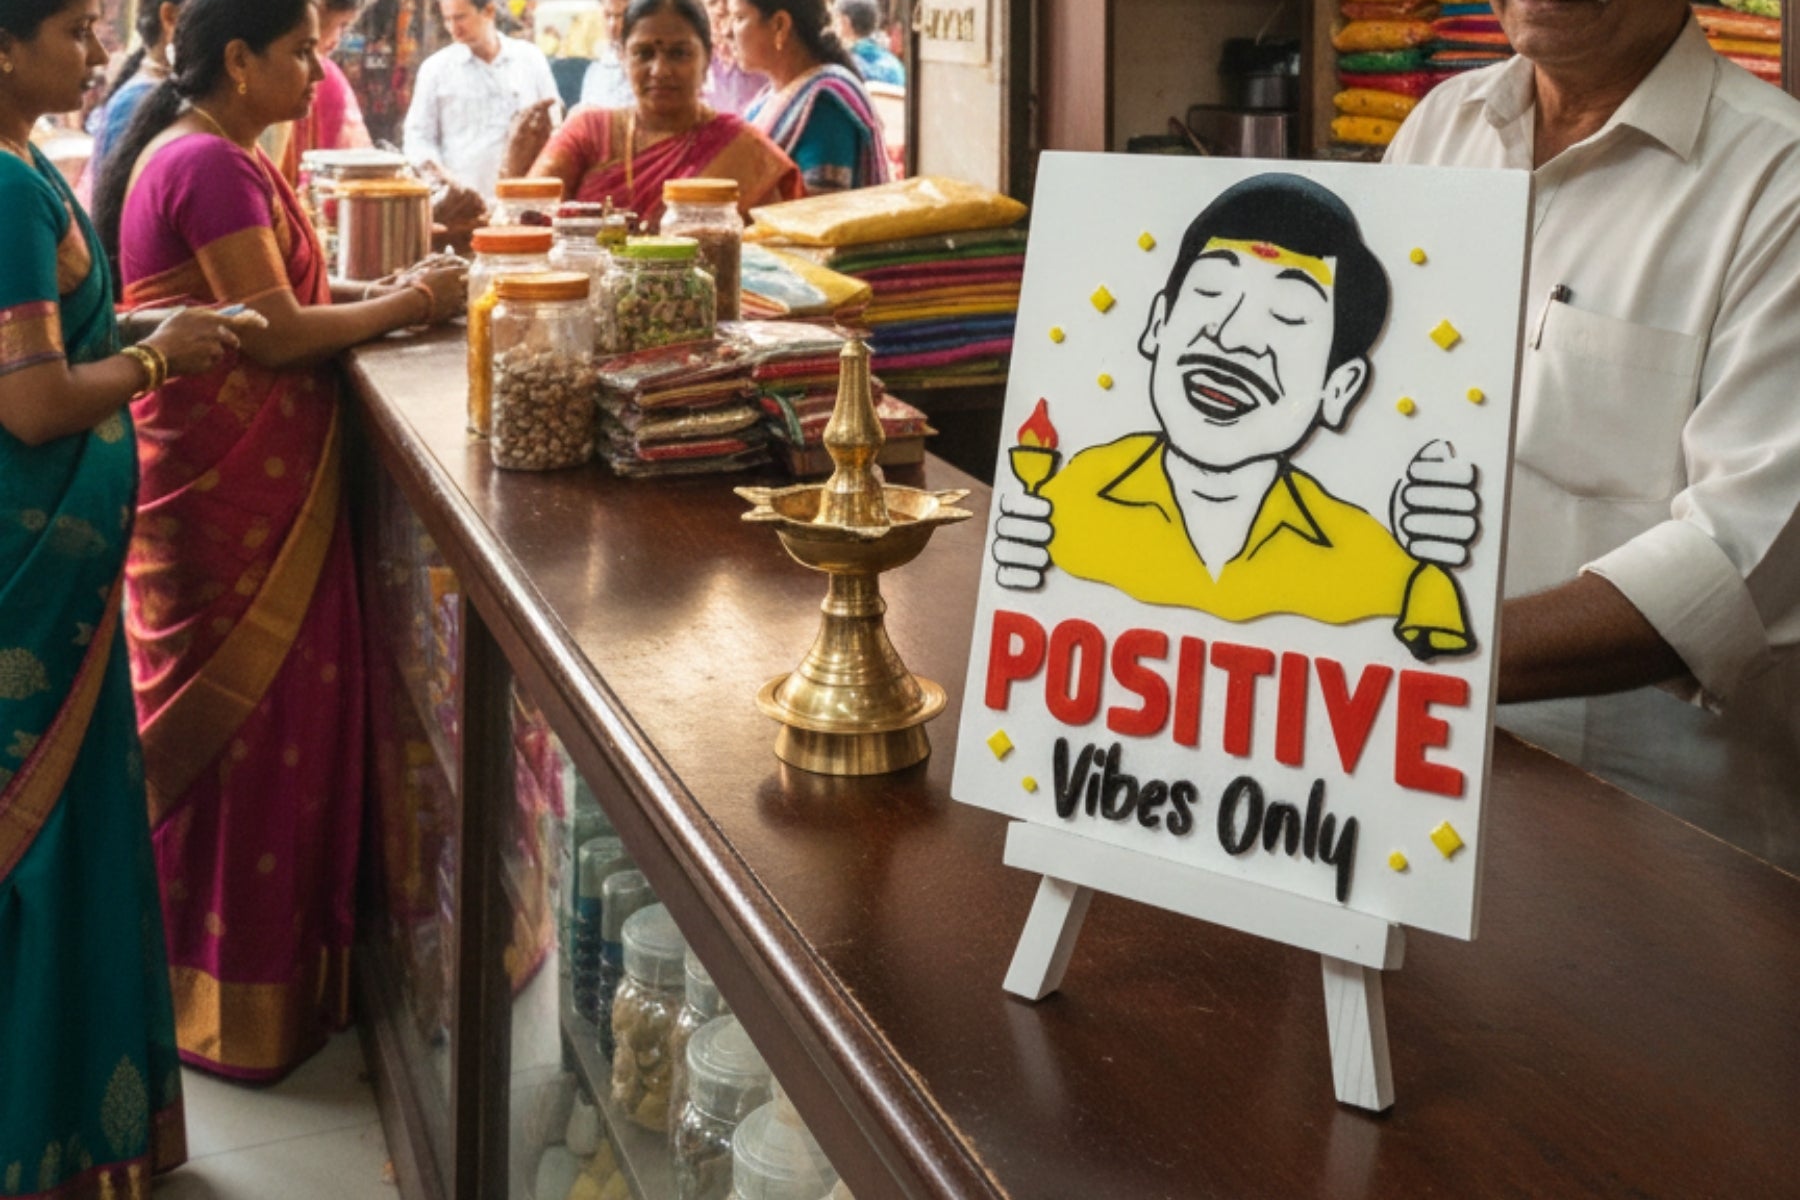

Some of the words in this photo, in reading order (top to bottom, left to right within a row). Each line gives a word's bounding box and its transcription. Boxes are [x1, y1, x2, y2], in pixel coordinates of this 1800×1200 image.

[985, 609, 1468, 797] POSITIVE
[1053, 737, 1198, 836] Vibes
[1217, 775, 1358, 902] Only
